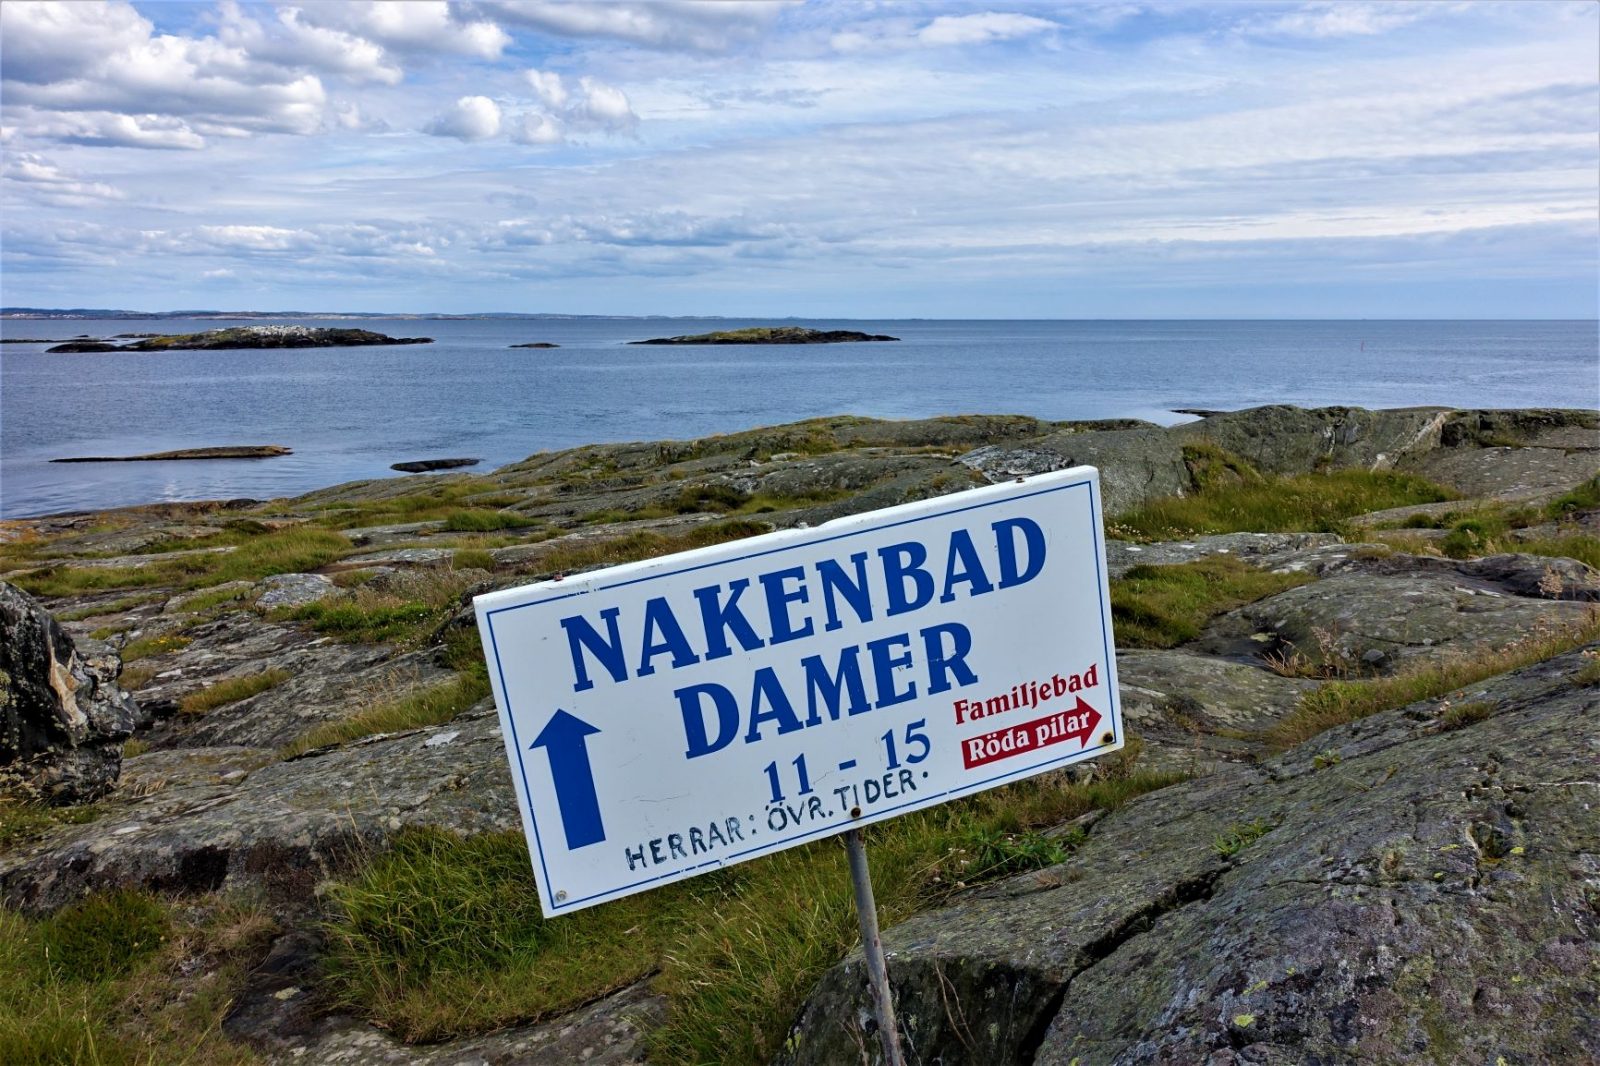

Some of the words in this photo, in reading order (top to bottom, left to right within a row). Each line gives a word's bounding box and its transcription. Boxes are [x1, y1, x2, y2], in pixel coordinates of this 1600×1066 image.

[560, 517, 1047, 692] NAKENBAD
[673, 621, 978, 759] DAMER
[954, 664, 1099, 725] Familjebad
[763, 753, 814, 804] 11
[839, 760, 857, 771] -
[881, 718, 931, 771] 15
[967, 727, 1030, 762] Röda
[1036, 710, 1091, 747] pilar
[625, 814, 757, 872] HERRAR:
